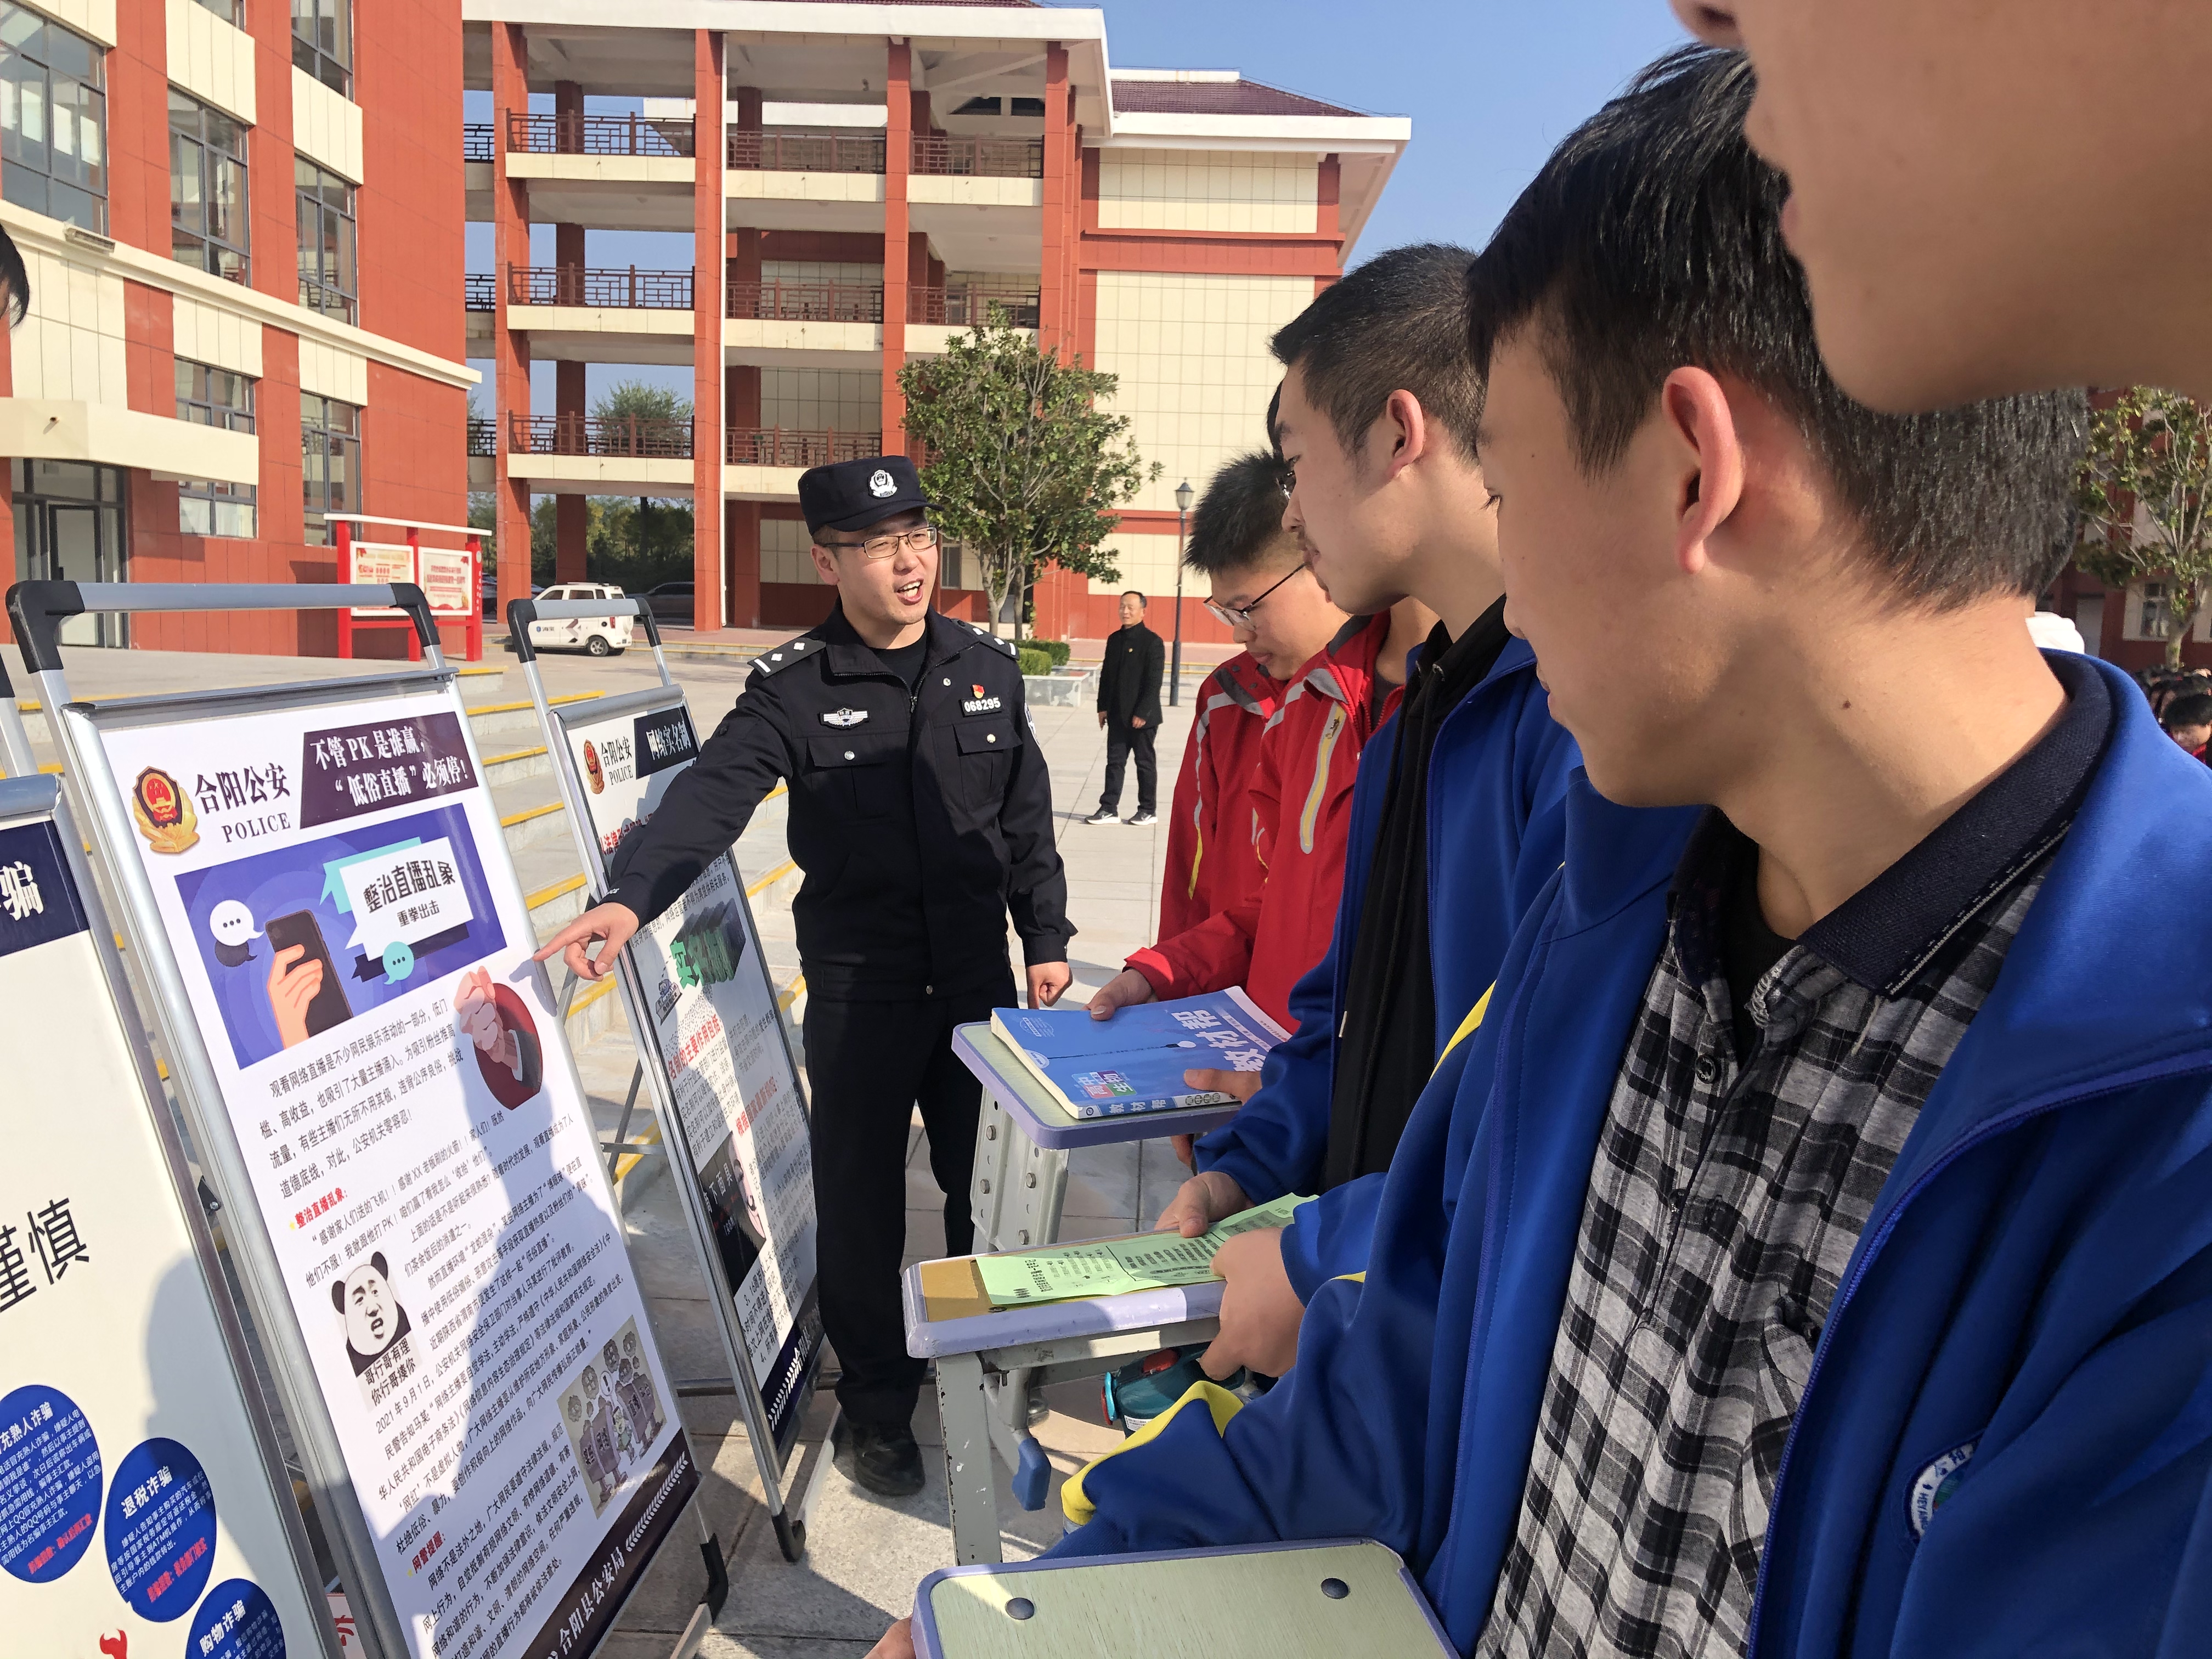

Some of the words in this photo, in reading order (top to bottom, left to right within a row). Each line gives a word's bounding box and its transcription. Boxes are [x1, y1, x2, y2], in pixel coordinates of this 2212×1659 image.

[964, 697, 1001, 712] 068295
[597, 735, 633, 768] 合阳公安
[645, 719, 692, 761] 网络实名制
[189, 760, 293, 816] 合阳公安
[607, 764, 634, 786] POLICE
[221, 811, 291, 844] POLICE
[362, 858, 456, 913] 整治直播乱象
[396, 898, 440, 928] 重拳出击
[269, 997, 448, 1100] 观看网络直播是不少网民娱乐活动的一部分，低门
[258, 1022, 456, 1142] 槛、高收益，也吸引了大量主播涌入。为吸引粉丝推高
[269, 1046, 464, 1171] 流量，有些主播们无所不用其极，违背公序良俗，挑战
[1078, 1076, 1108, 1096] 高中
[1104, 1071, 1135, 1094] 生物
[1109, 1099, 1166, 1114] 教材帮
[279, 1107, 413, 1201] 道德底线，对此，公安机关零容忍！
[294, 1183, 348, 1230] 整治直播乱象：
[404, 1216, 471, 1279] 们茶余饭后的消遣之一。
[364, 1335, 410, 1389] 哥行哥有理
[370, 1354, 416, 1409] 你行哥揍你
[0, 1401, 53, 1454] 充熟人诈骗
[121, 1465, 173, 1520] 退税诈骗
[557, 1542, 625, 1659] 合阳县公安局
[199, 1600, 246, 1657] 购物诈骗
